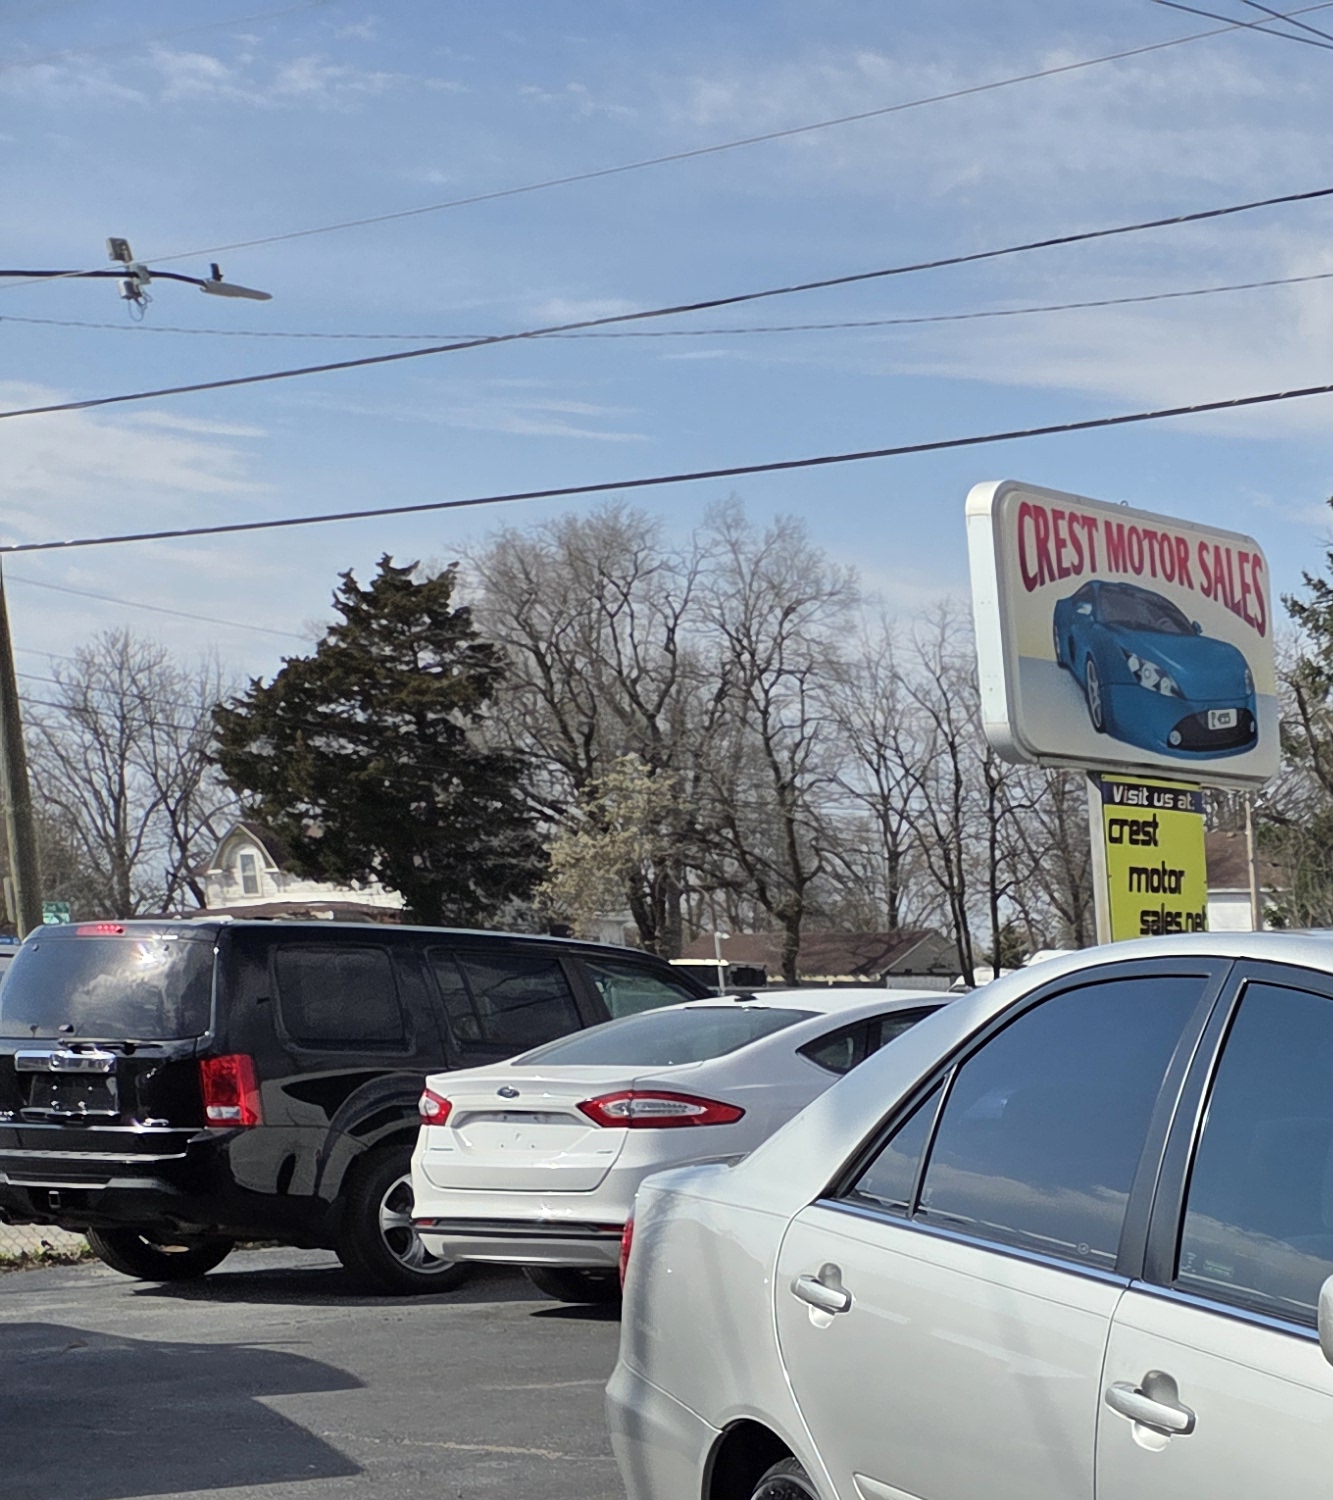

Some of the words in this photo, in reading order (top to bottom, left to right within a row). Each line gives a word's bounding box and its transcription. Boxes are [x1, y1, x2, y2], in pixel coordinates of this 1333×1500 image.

[1018, 501, 1099, 592] CREST
[1104, 520, 1195, 591] MOTOR
[1197, 540, 1267, 638] SALES
[1113, 784, 1149, 806] Visit
[1153, 791, 1174, 808] us
[1108, 813, 1159, 847] crest
[1128, 860, 1185, 895] motor
